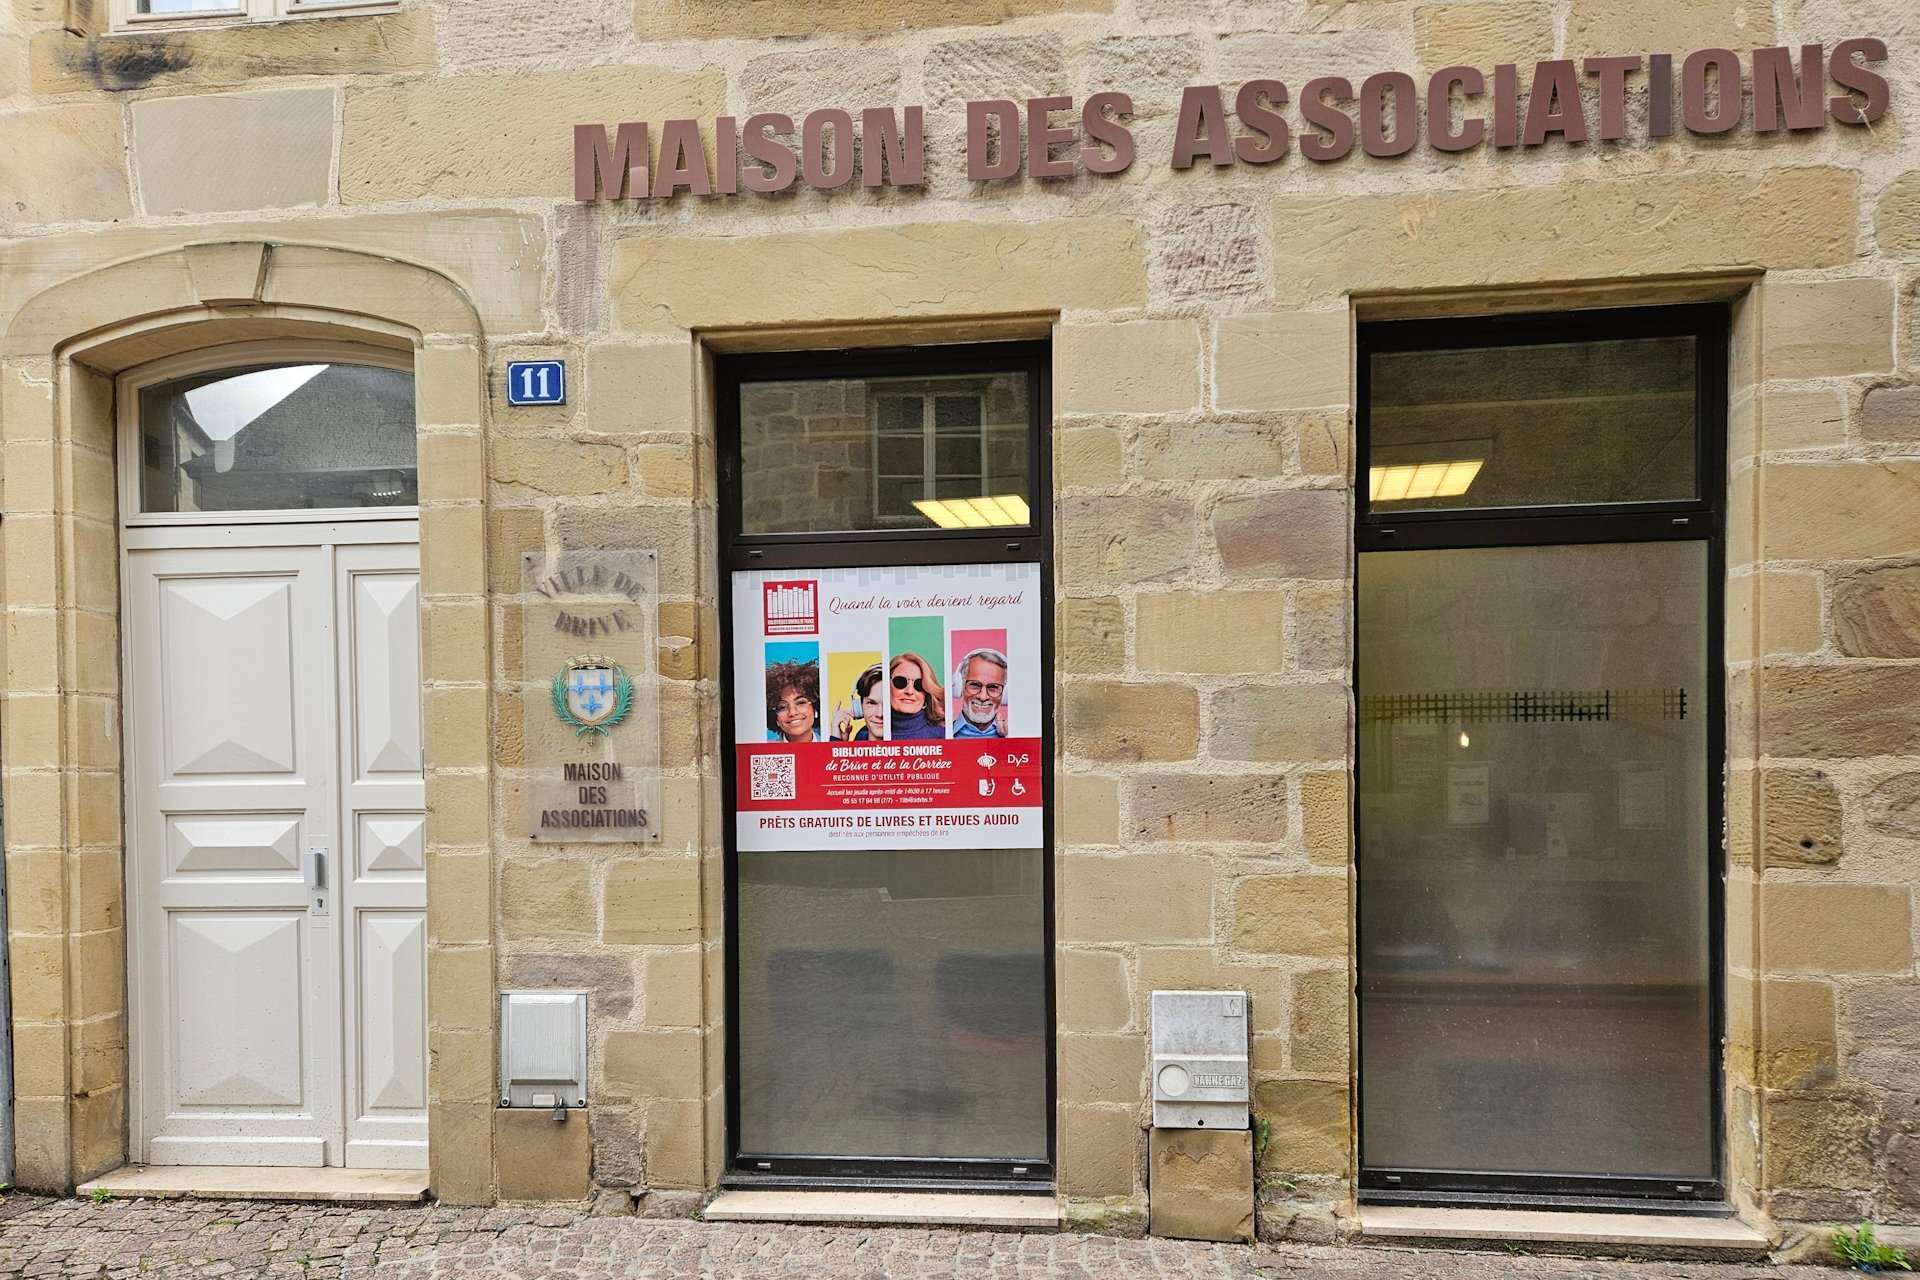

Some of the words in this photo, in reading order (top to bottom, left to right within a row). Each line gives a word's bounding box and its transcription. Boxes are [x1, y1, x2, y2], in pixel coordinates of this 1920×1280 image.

[573, 104, 924, 201] MAISON
[967, 91, 1136, 181] DES
[1170, 37, 1890, 170] ASSOCIATIONS
[521, 368, 550, 398] 11
[535, 565, 610, 600] VILLE
[612, 571, 647, 602] DE
[828, 596, 875, 615] Quand
[878, 596, 891, 609] la
[897, 597, 922, 608] voix
[927, 593, 973, 608] devient
[977, 591, 1024, 610] regard
[555, 609, 633, 637] BRIVE
[832, 745, 901, 757] BIBLIOTHÈQUE
[903, 745, 942, 756] SONORE
[825, 759, 838, 771] de
[840, 759, 869, 772] Brive
[871, 759, 881, 770] et
[884, 759, 897, 770] de
[900, 759, 910, 770] la
[912, 758, 952, 771] Corrèze
[1007, 753, 1029, 768] DyS
[564, 763, 621, 781] MAISON
[833, 774, 869, 782] RECONNUE
[872, 772, 904, 781] D'UTILITÉ
[907, 772, 940, 780] PUBLIQUE
[579, 786, 607, 805] DES
[541, 809, 647, 828] ASSOCIATIONS
[759, 815, 796, 829] PRÊTS
[799, 816, 854, 829] GRATUITS
[857, 816, 872, 828] DE
[875, 816, 915, 828] LIVRES
[918, 815, 933, 827] ET
[935, 815, 980, 827] REVUES
[983, 814, 1019, 826] AUDIO
[865, 831, 895, 839] personnes
[896, 829, 929, 838] empêchées
[930, 829, 938, 837] de
[1194, 1074, 1223, 1086] VANNE
[1224, 1074, 1243, 1087] GAZ
